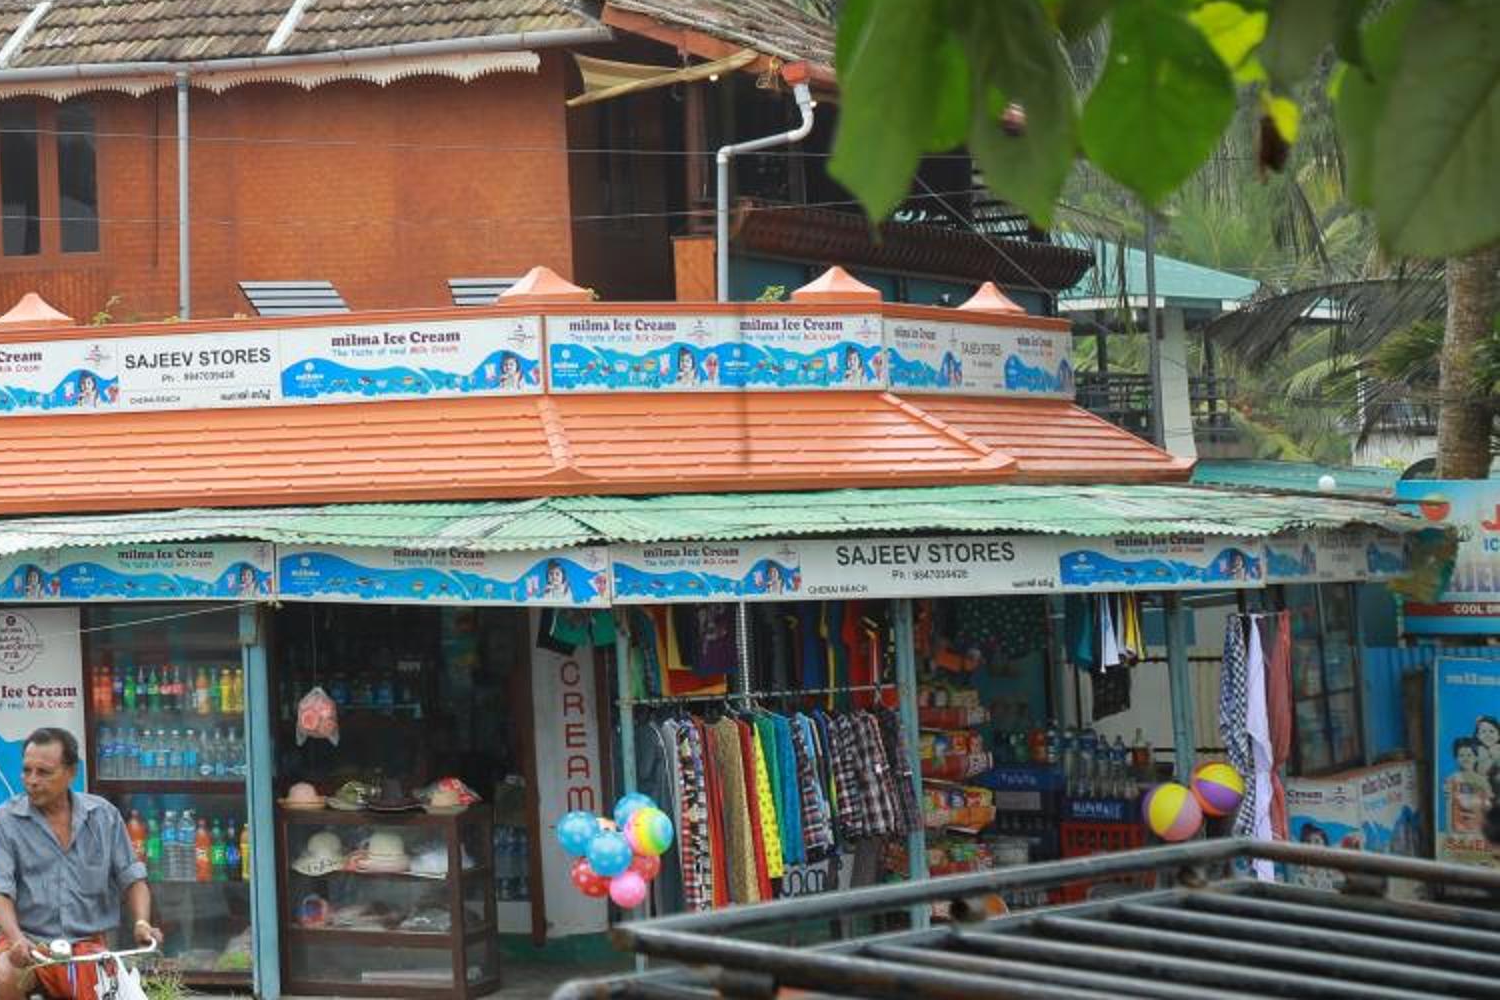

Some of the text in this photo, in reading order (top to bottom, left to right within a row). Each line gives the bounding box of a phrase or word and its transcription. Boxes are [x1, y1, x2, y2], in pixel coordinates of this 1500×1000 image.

[569, 319, 676, 332] milma Ice Cream
[739, 318, 843, 331] milma Ice Cream
[331, 330, 460, 347] milma Ice Cream
[125, 347, 271, 369] SAJEEV STORES
[117, 548, 214, 560] milma Ice Cream
[643, 547, 739, 558] milma Ice Cream
[836, 542, 1015, 566] SAJEEV STORES
[1452, 603, 1482, 614] COOL
[1, 685, 23, 699] Ice
[27, 684, 77, 698] Cream
[560, 661, 596, 812] CREAM
